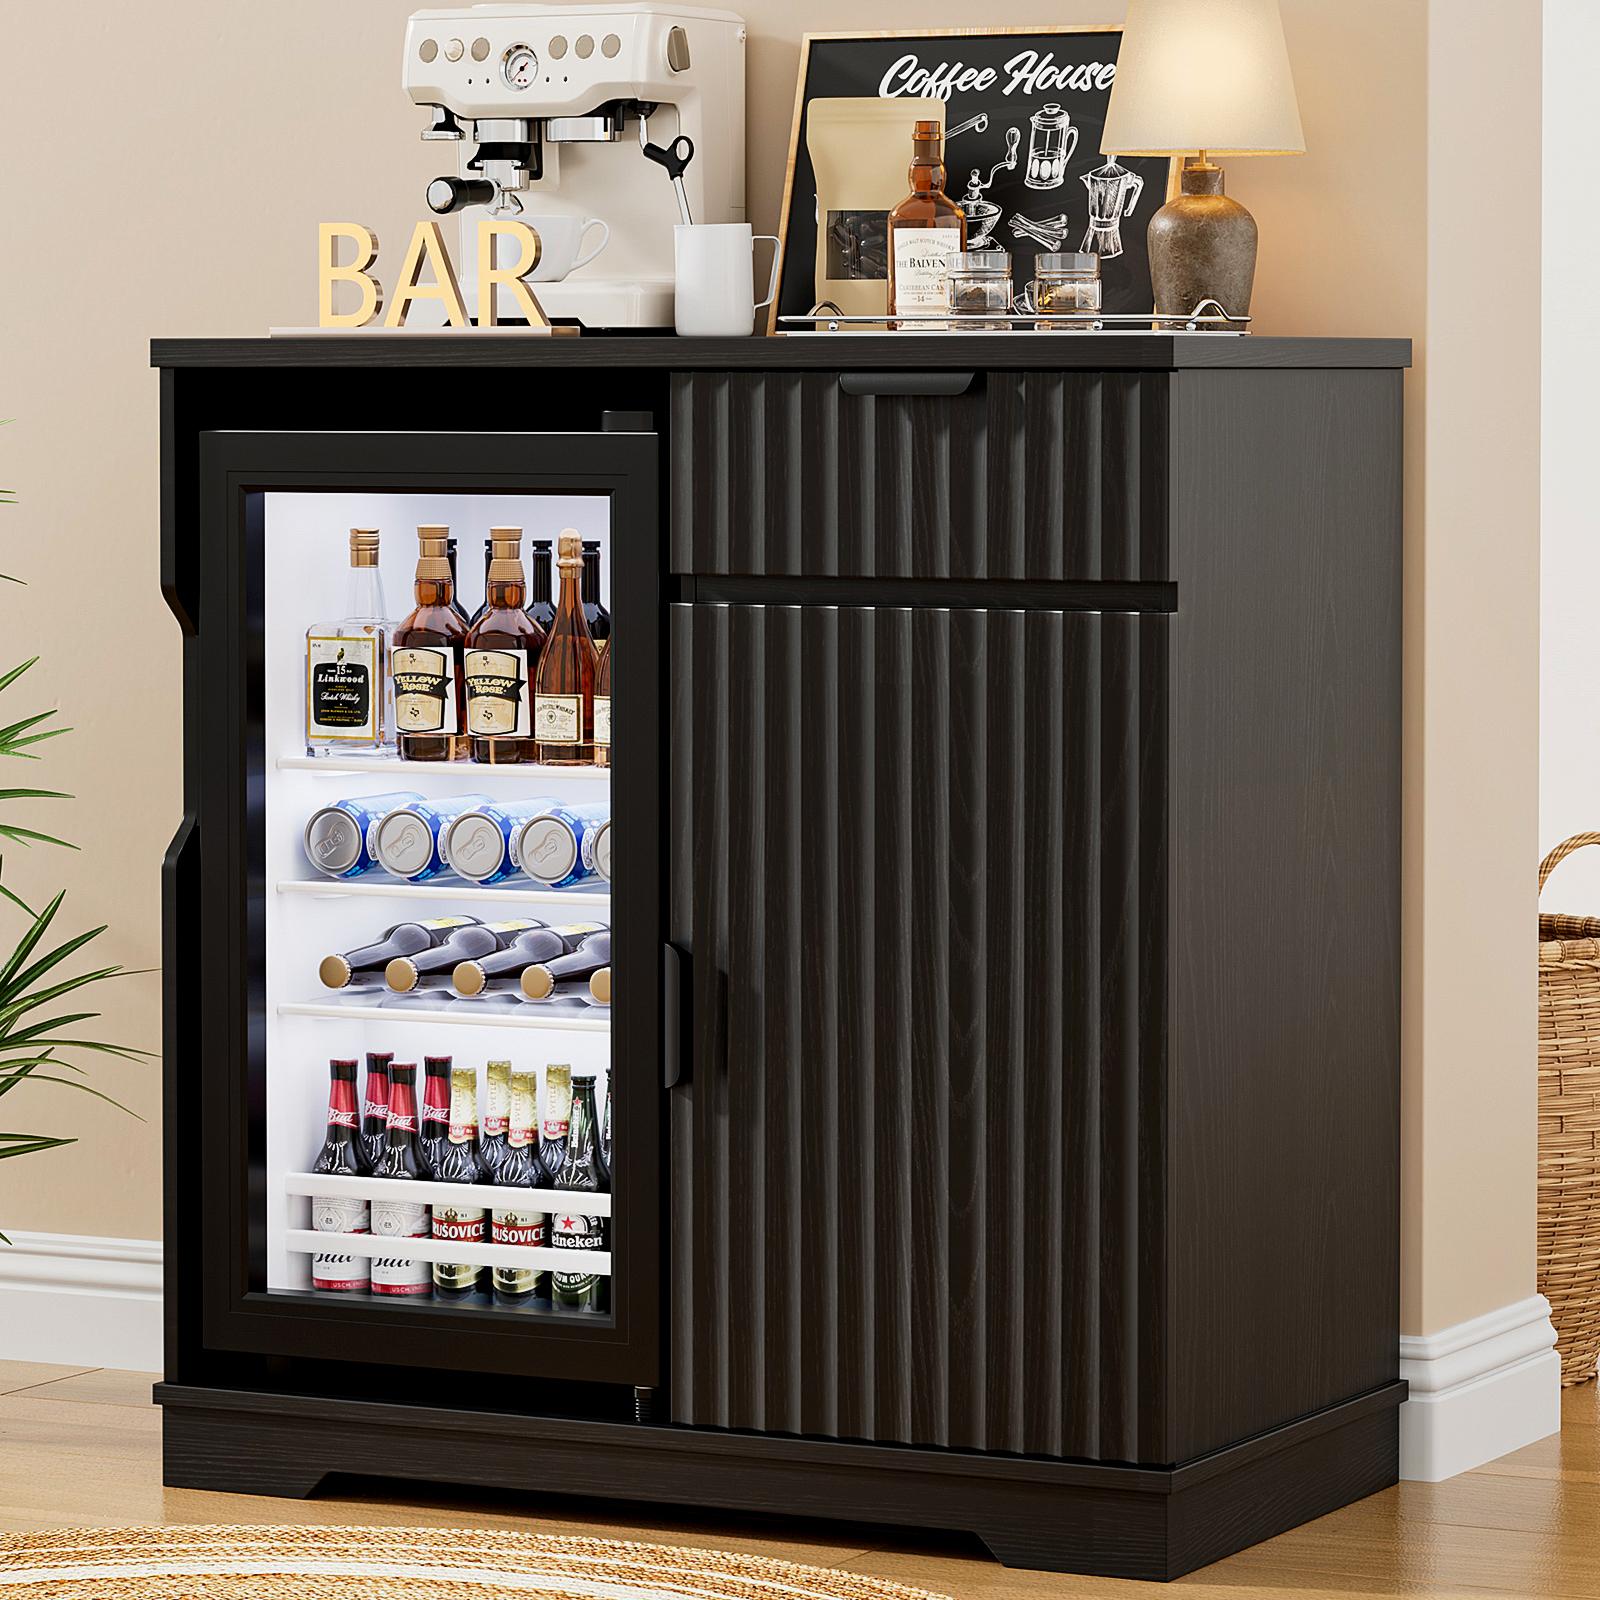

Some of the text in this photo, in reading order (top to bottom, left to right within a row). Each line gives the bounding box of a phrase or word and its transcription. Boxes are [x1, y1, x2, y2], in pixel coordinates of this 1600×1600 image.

[878, 49, 1117, 102] Coffee House
[319, 221, 552, 327] BAR
[336, 665, 346, 675] 15
[317, 674, 365, 684] Linkwood
[394, 675, 443, 686] YELLOW
[466, 678, 517, 688] YELLOW
[328, 1108, 353, 1123] Bud
[386, 1112, 412, 1127] Bud
[423, 1105, 448, 1120] Bud
[432, 1222, 486, 1239] RUŠOVICE
[492, 1226, 545, 1243] RUŠOVICE
[552, 1233, 603, 1248] eineken
